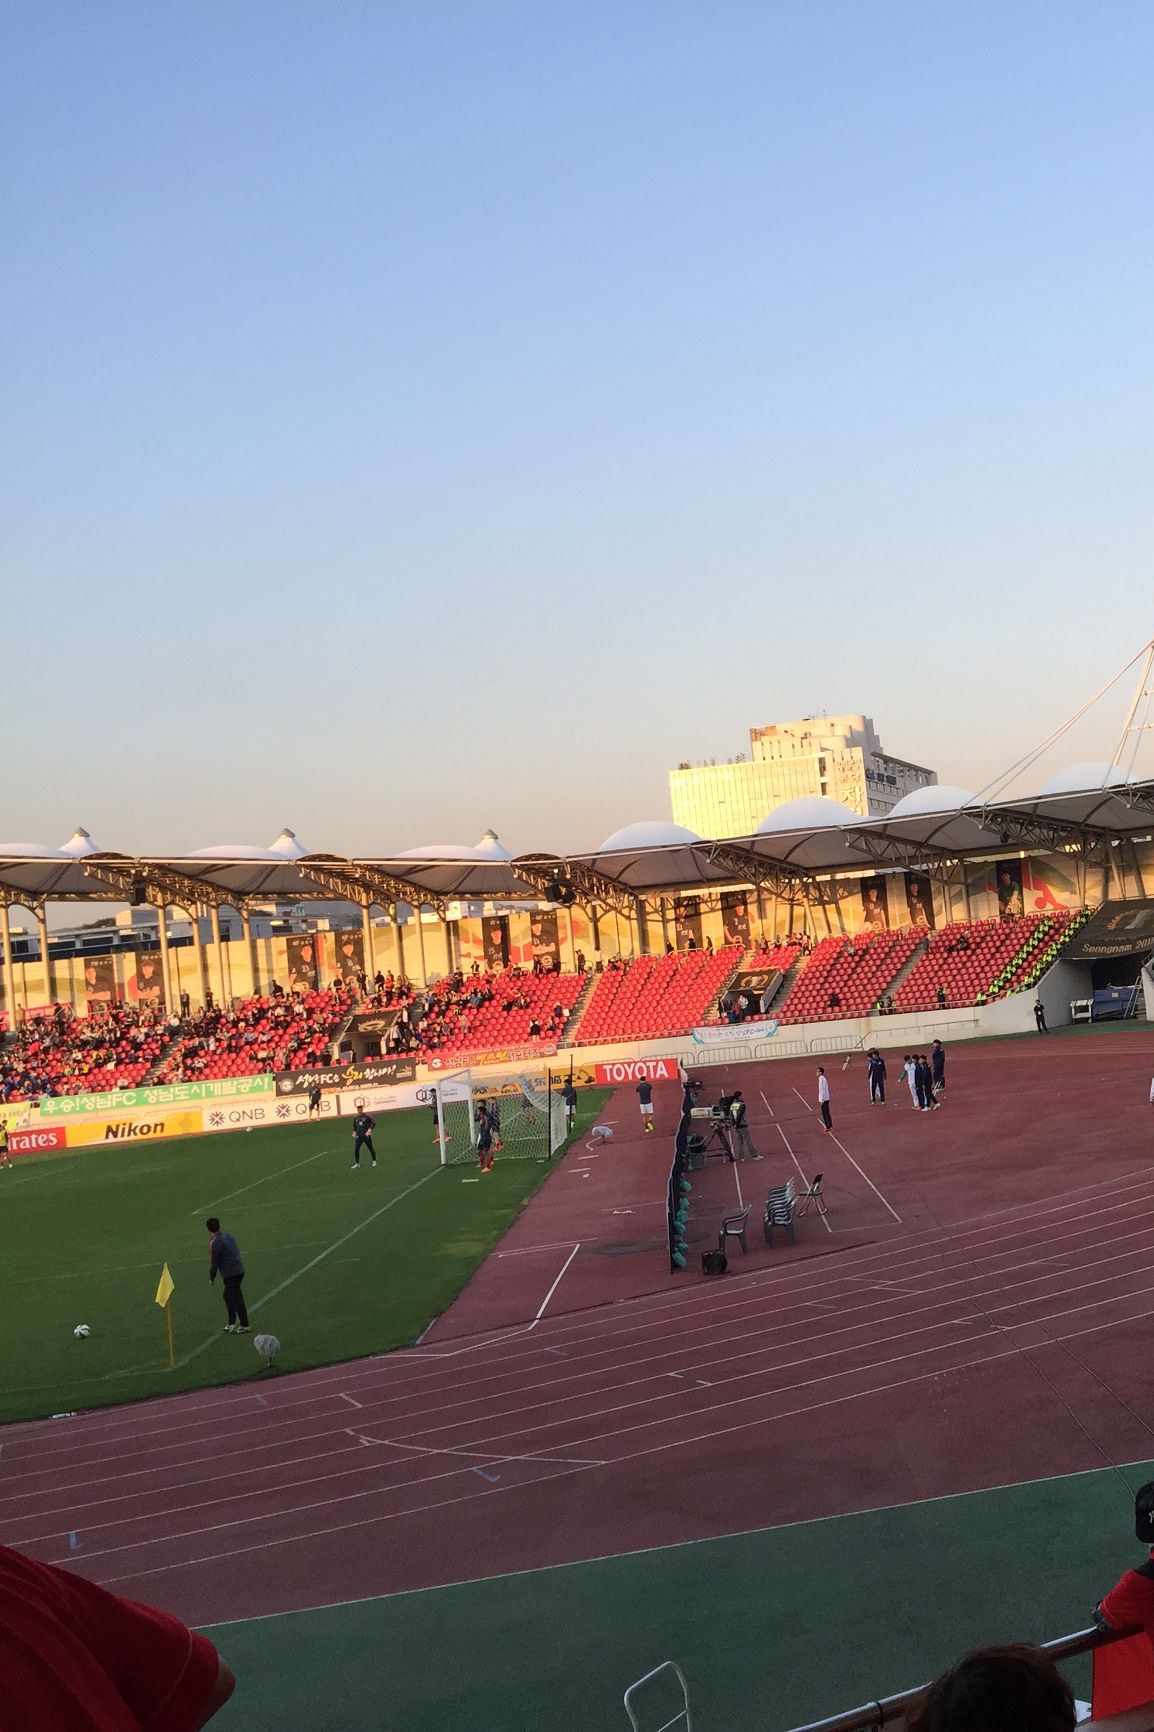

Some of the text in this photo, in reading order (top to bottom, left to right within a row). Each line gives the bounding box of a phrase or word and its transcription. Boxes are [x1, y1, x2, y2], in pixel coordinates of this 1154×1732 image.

[1082, 943, 1133, 954] Seongnam
[603, 1060, 669, 1083] TOYOTA
[142, 1077, 271, 1105] 성남도시개발공사
[229, 1108, 266, 1124] QNB
[104, 1119, 166, 1140] Nikon
[7, 1131, 58, 1151] irates
